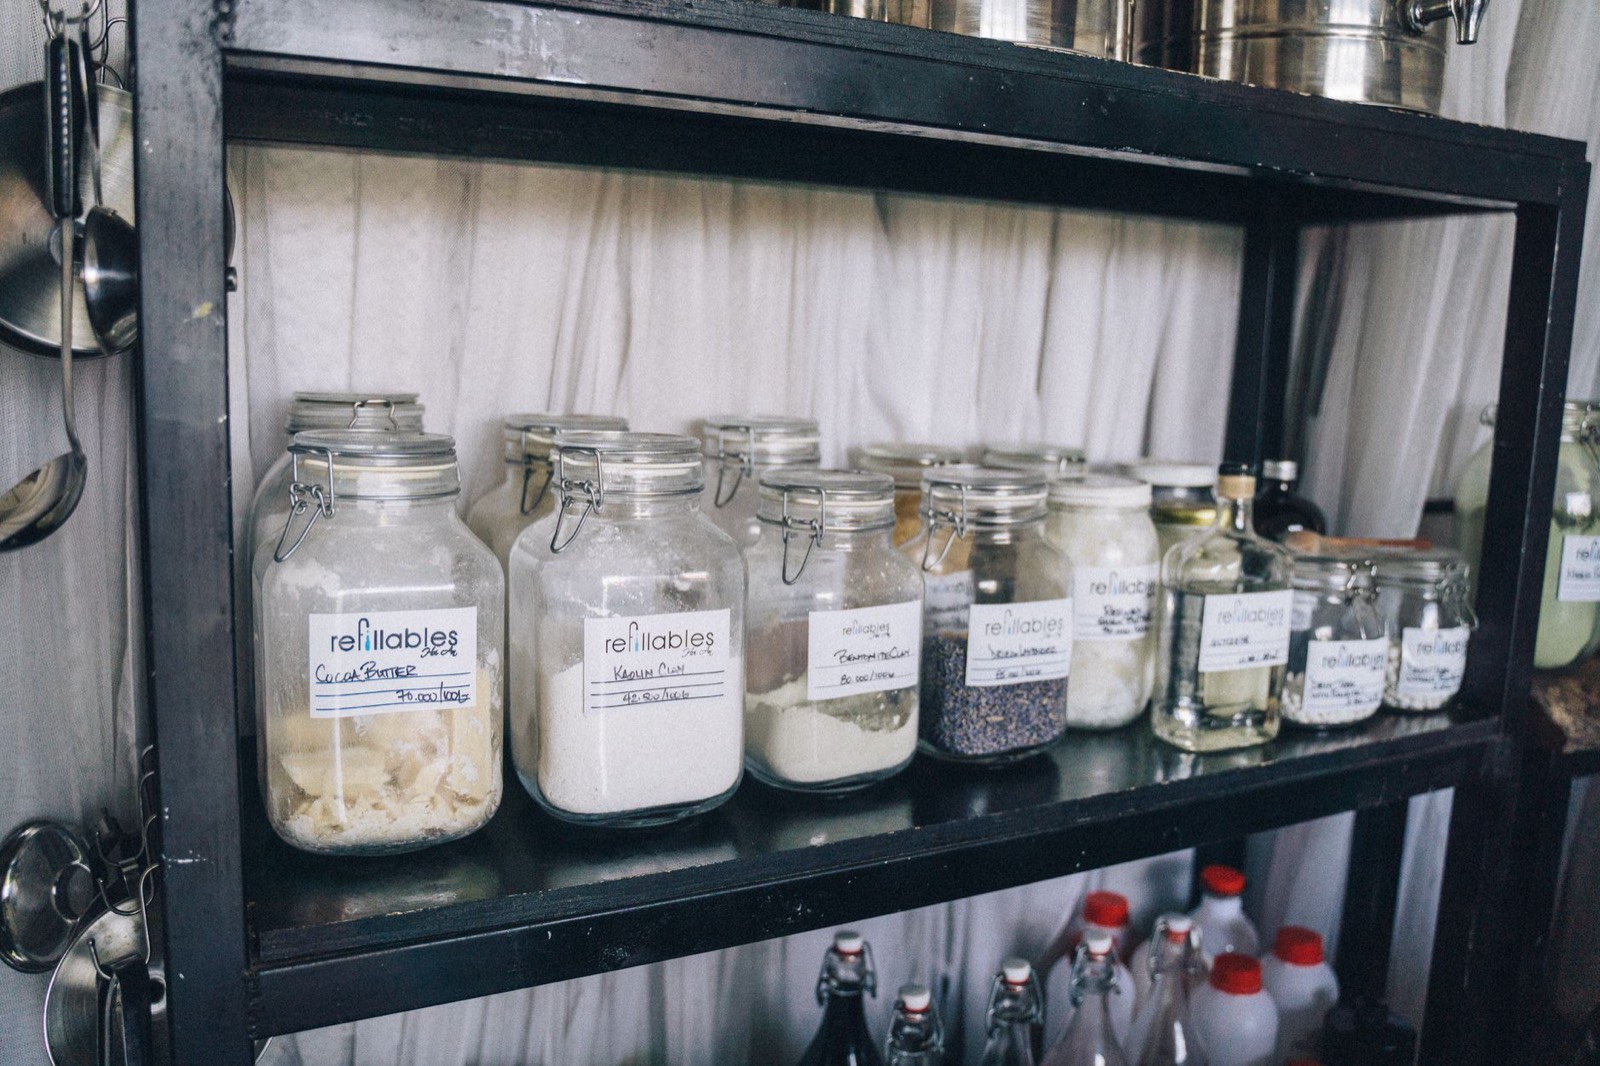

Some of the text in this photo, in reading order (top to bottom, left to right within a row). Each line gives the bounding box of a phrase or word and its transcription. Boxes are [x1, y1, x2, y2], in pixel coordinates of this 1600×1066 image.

[1089, 571, 1155, 597] refillab
[331, 618, 458, 652] refillables
[842, 619, 890, 635] refillables
[985, 609, 1064, 636] refillables
[605, 621, 715, 653] refillables
[360, 661, 418, 682] BUTTER
